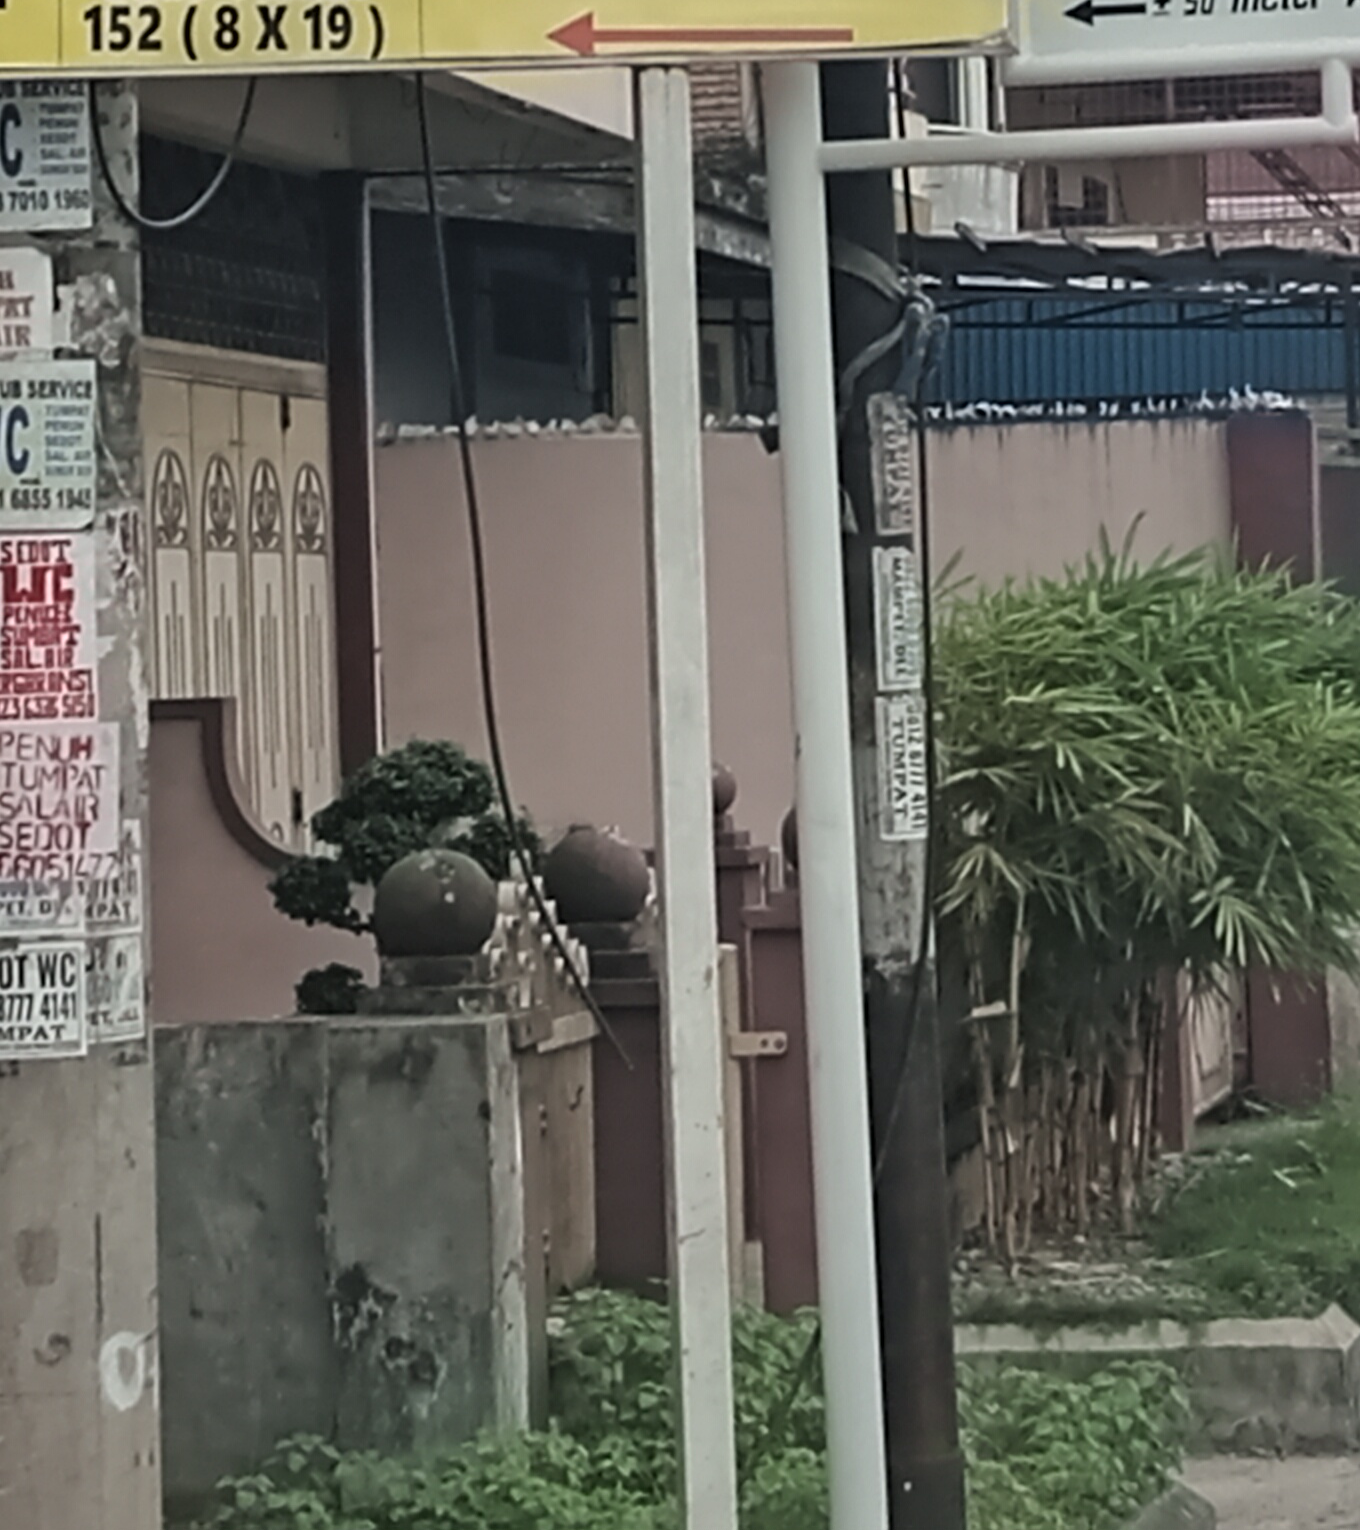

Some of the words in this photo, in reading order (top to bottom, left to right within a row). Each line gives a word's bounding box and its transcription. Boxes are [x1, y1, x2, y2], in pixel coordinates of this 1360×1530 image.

[83, 5, 163, 52] 152
[255, 6, 290, 52] X
[27, 378, 94, 400] SERVICE
[0, 539, 72, 565] SEDOT
[0, 762, 107, 792] TUMPAT
[891, 715, 909, 820] TUMPAT
[37, 951, 77, 989] WC
[39, 991, 78, 1022] 4141
